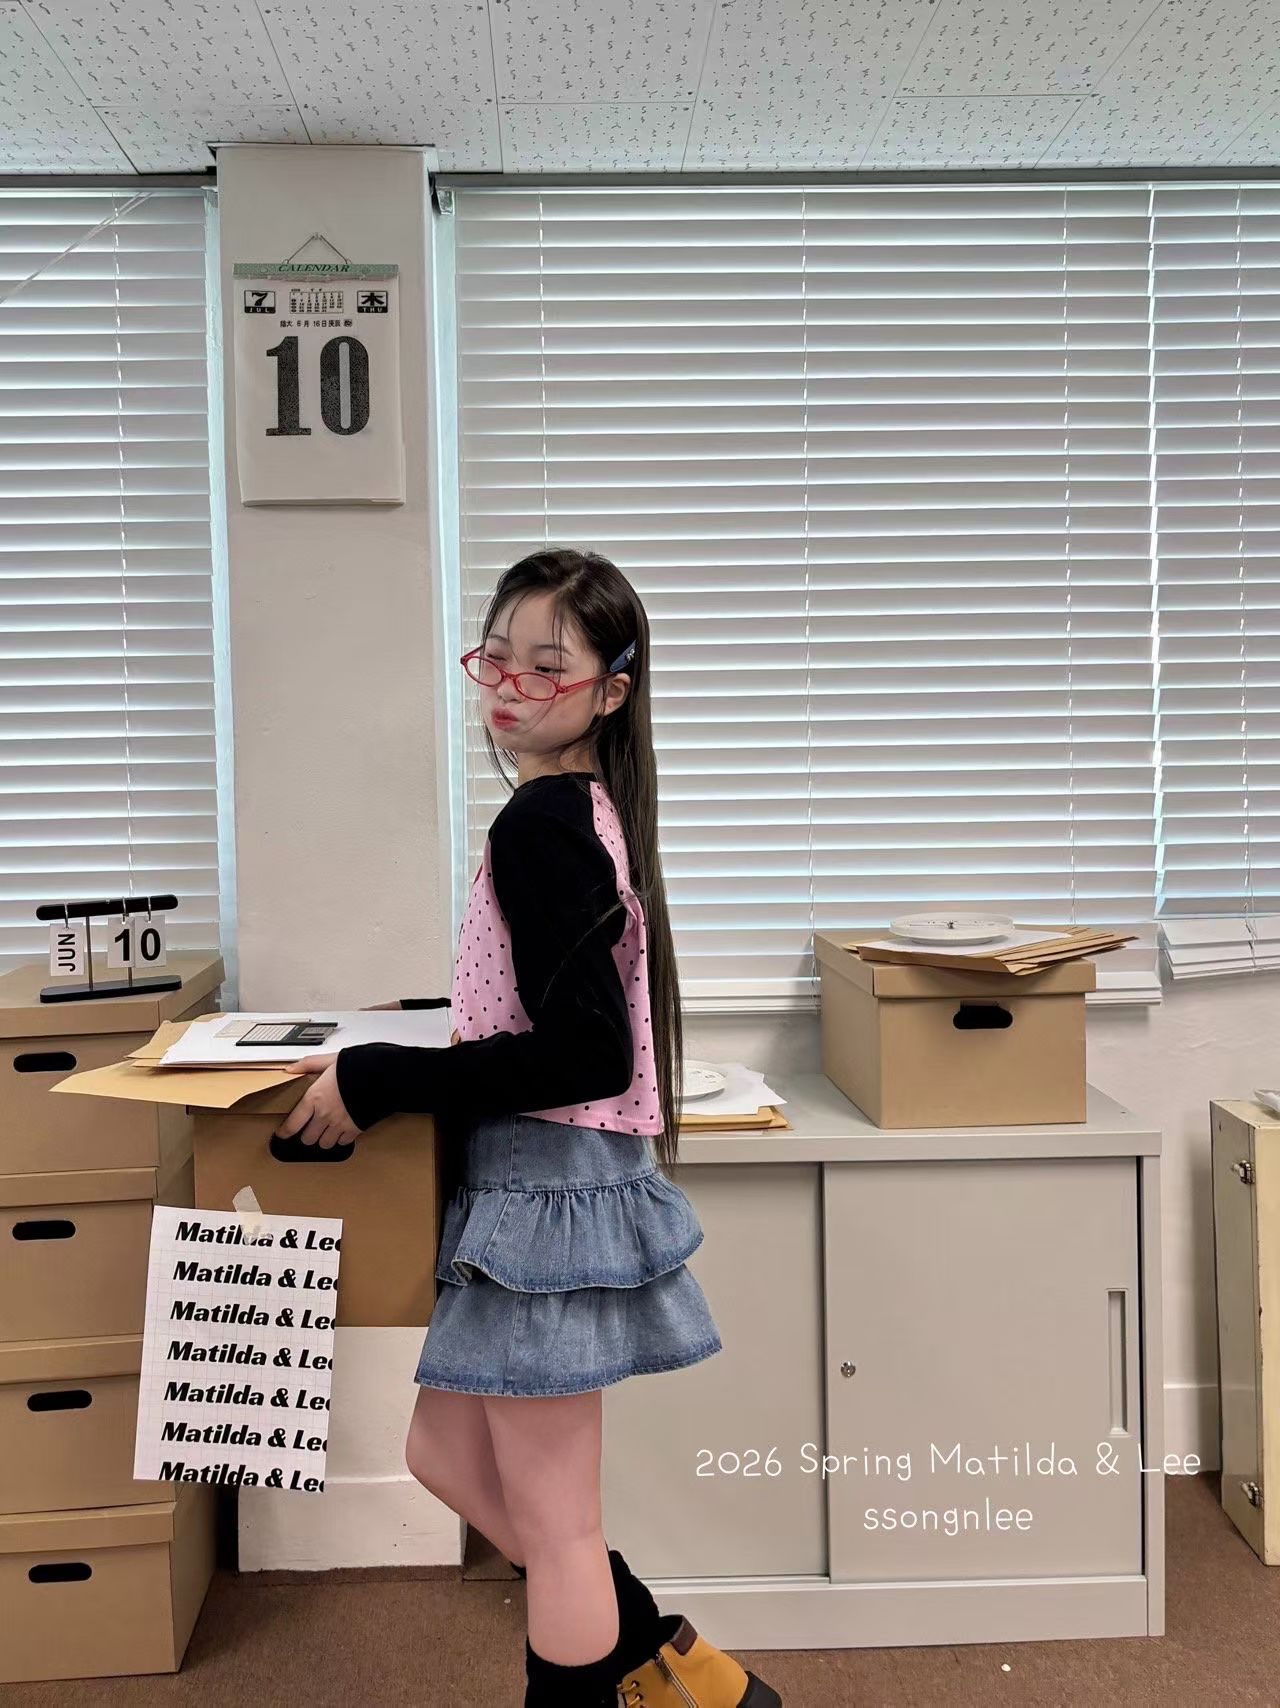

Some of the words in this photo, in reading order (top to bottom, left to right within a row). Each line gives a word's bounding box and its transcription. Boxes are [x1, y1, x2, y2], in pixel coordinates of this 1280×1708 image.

[278, 263, 350, 272] CALENDAR
[251, 292, 268, 306] 7
[360, 292, 385, 306] 木
[266, 336, 369, 435] 10
[58, 933, 76, 972] JUN
[114, 928, 161, 962] 10
[280, 1229, 299, 1249] &
[172, 1260, 272, 1287] Matilda
[277, 1268, 297, 1288] &
[170, 1301, 270, 1326] Matilda
[275, 1308, 294, 1328] &
[167, 1341, 267, 1366] Matilda
[273, 1348, 292, 1368] &
[298, 1349, 333, 1371] Le
[164, 1381, 265, 1406] Matilda
[270, 1388, 289, 1408] &
[296, 1389, 331, 1411] Le
[161, 1421, 262, 1446] Matilda
[268, 1428, 287, 1448] &
[159, 1461, 259, 1487] Matilda
[264, 1467, 284, 1488] &
